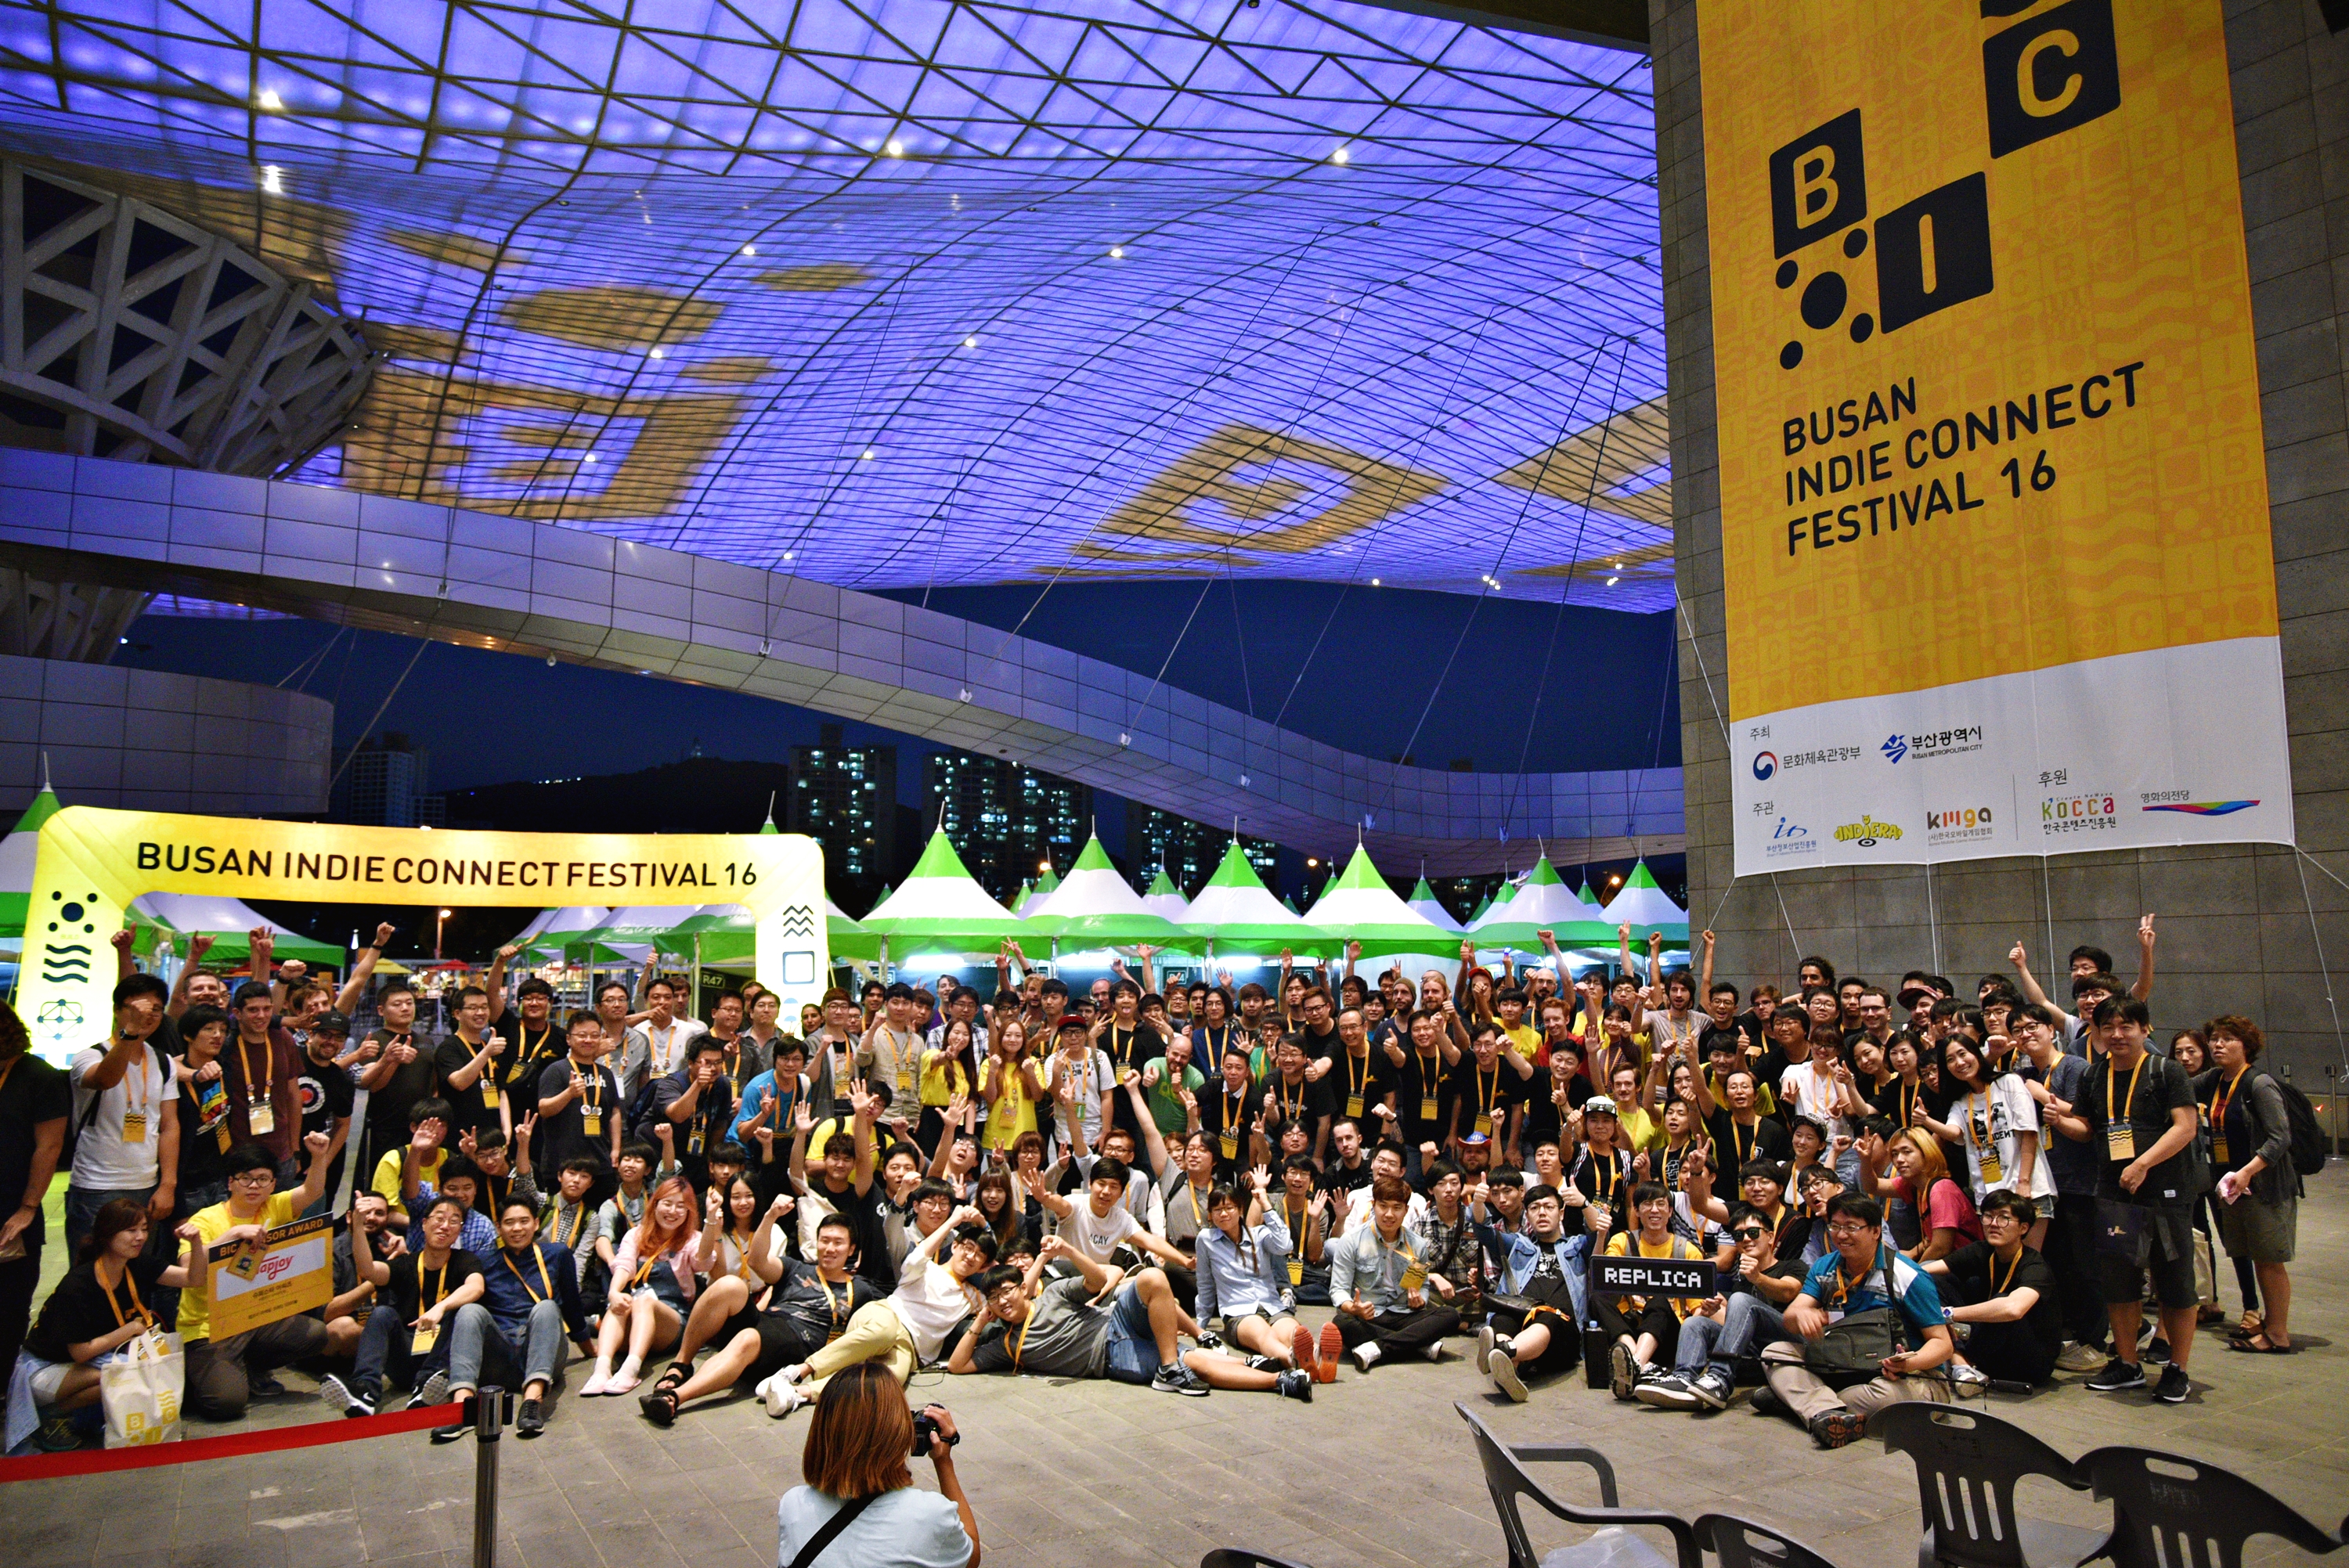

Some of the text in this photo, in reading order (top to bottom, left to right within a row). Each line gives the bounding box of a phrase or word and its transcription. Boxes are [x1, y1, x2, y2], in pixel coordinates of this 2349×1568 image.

[2017, 29, 2083, 117] C
[1793, 144, 1839, 229] B
[1918, 214, 1937, 294] I
[1783, 377, 1916, 456] BUSAN
[1786, 361, 2145, 506] INDIE CONNECT
[1788, 449, 2056, 557] FESTIVAL 16
[1750, 725, 1770, 741] 주최
[1911, 726, 1982, 751] 부산광역시
[1783, 746, 1861, 770] 문화체육관광부
[1928, 745, 1969, 757] METROPOLITAN
[2038, 768, 2067, 788] 후원
[1753, 800, 1774, 816] 주관
[2140, 790, 2190, 802] 영화의전당
[137, 842, 757, 887] BUSAN INDIE CONNECT FESTIVAL 16
[702, 975, 722, 986] R47
[288, 1219, 323, 1236] AWARD
[1604, 1267, 1701, 1289] REPLICA
